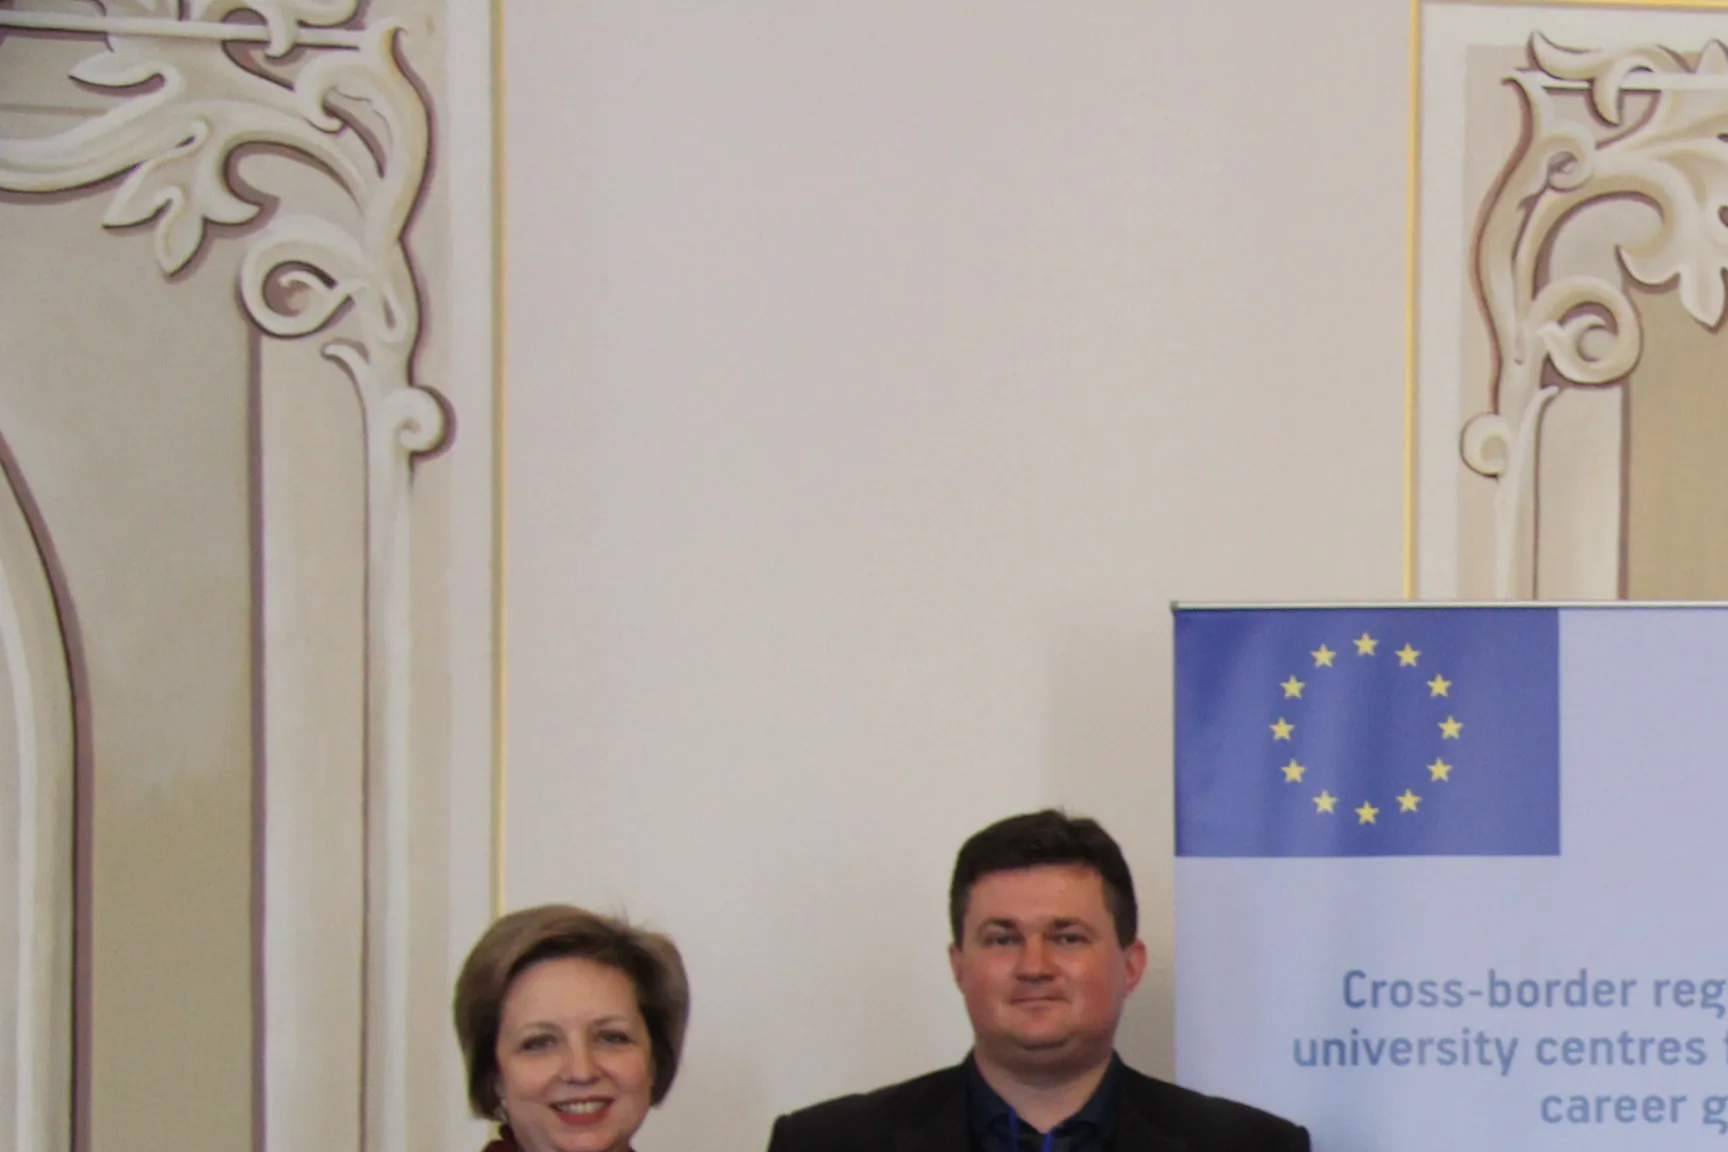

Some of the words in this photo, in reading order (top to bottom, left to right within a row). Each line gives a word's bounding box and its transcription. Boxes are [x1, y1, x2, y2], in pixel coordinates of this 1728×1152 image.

[1342, 968, 1636, 1009] Cross-border
[1293, 1026, 1518, 1077] university
[1536, 1029, 1708, 1067] centres
[1539, 1090, 1687, 1125] career
